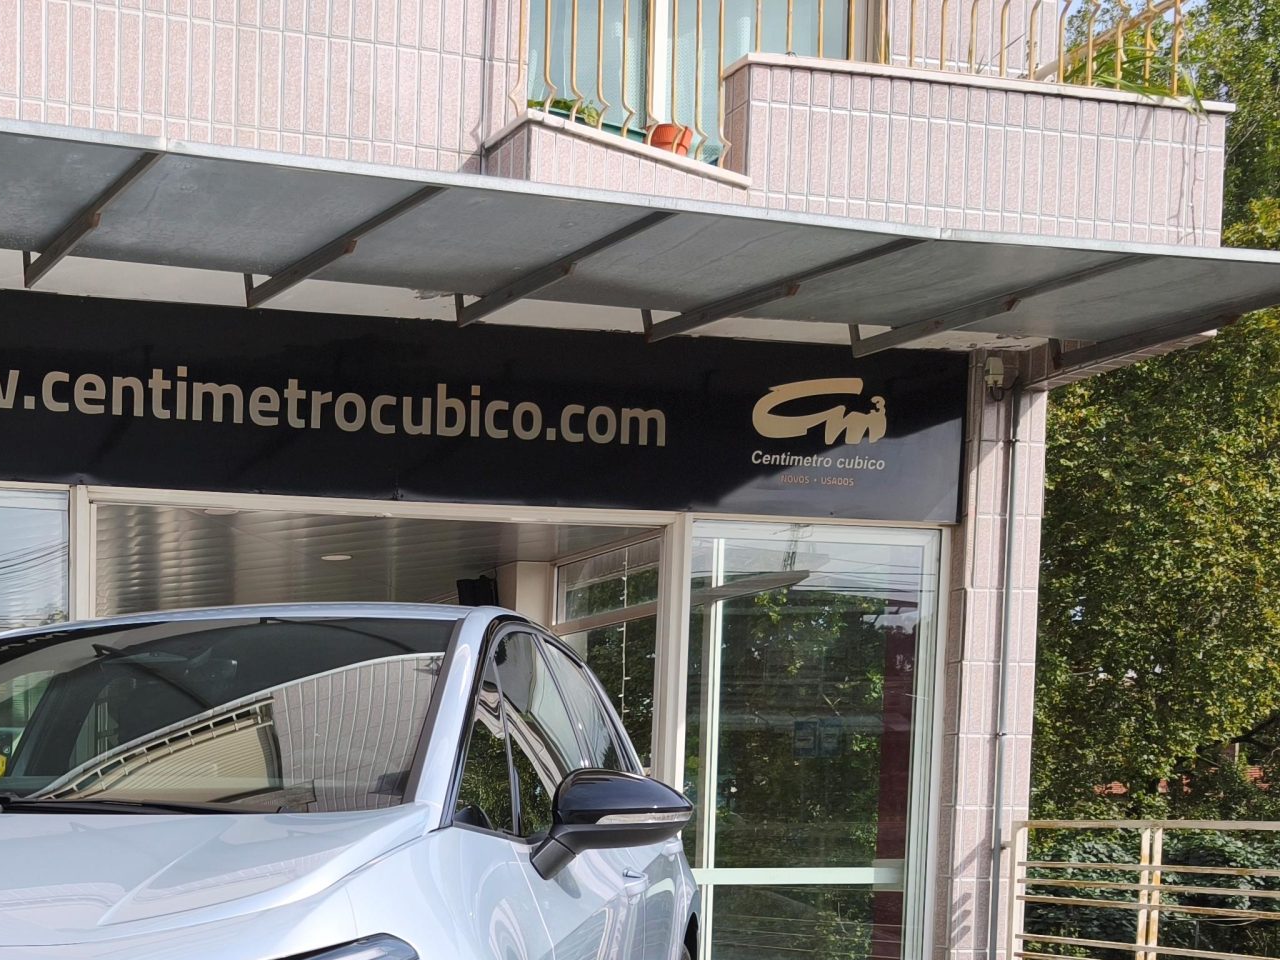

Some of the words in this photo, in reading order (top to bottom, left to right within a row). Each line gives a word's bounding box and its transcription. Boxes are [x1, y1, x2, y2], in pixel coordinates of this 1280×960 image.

[751, 450, 832, 468] Centimetro
[836, 455, 886, 470] cubico
[780, 475, 810, 484] NOVOS
[821, 477, 855, 487] USADOS
